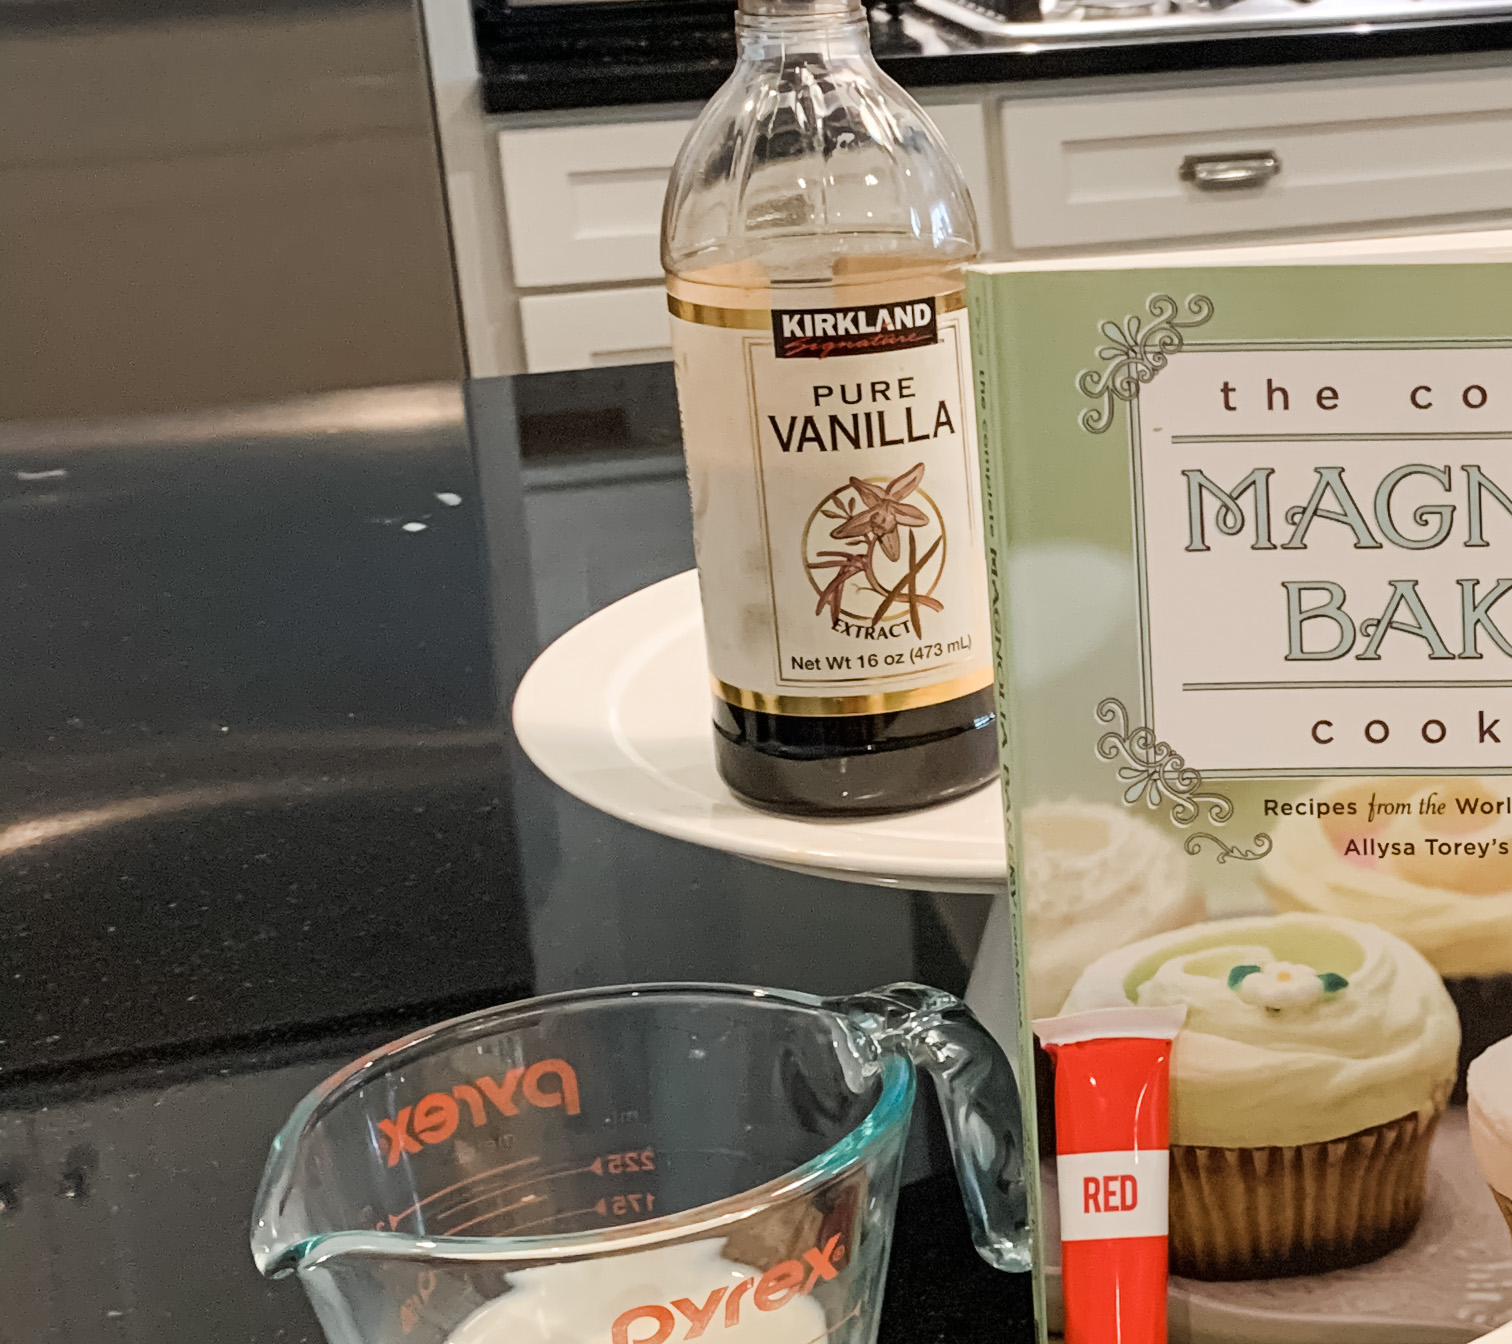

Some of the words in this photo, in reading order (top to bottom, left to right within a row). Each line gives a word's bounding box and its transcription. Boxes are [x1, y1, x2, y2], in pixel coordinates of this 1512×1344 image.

[781, 302, 932, 338] KIRKLAND
[812, 376, 917, 407] PURE
[1218, 378, 1342, 413] the
[767, 399, 956, 453] VANILLA
[831, 618, 911, 641] EXTRACT
[791, 655, 822, 671] Net
[825, 655, 853, 670] Wt
[857, 653, 879, 669] 16
[884, 653, 905, 666] oz
[909, 642, 944, 665] (473
[1264, 798, 1358, 819] Recipes
[1367, 792, 1413, 823] from
[1418, 791, 1447, 816] the
[1343, 837, 1416, 859] Allysa
[1424, 837, 1510, 859] Torey's
[1083, 1174, 1139, 1214] RED
